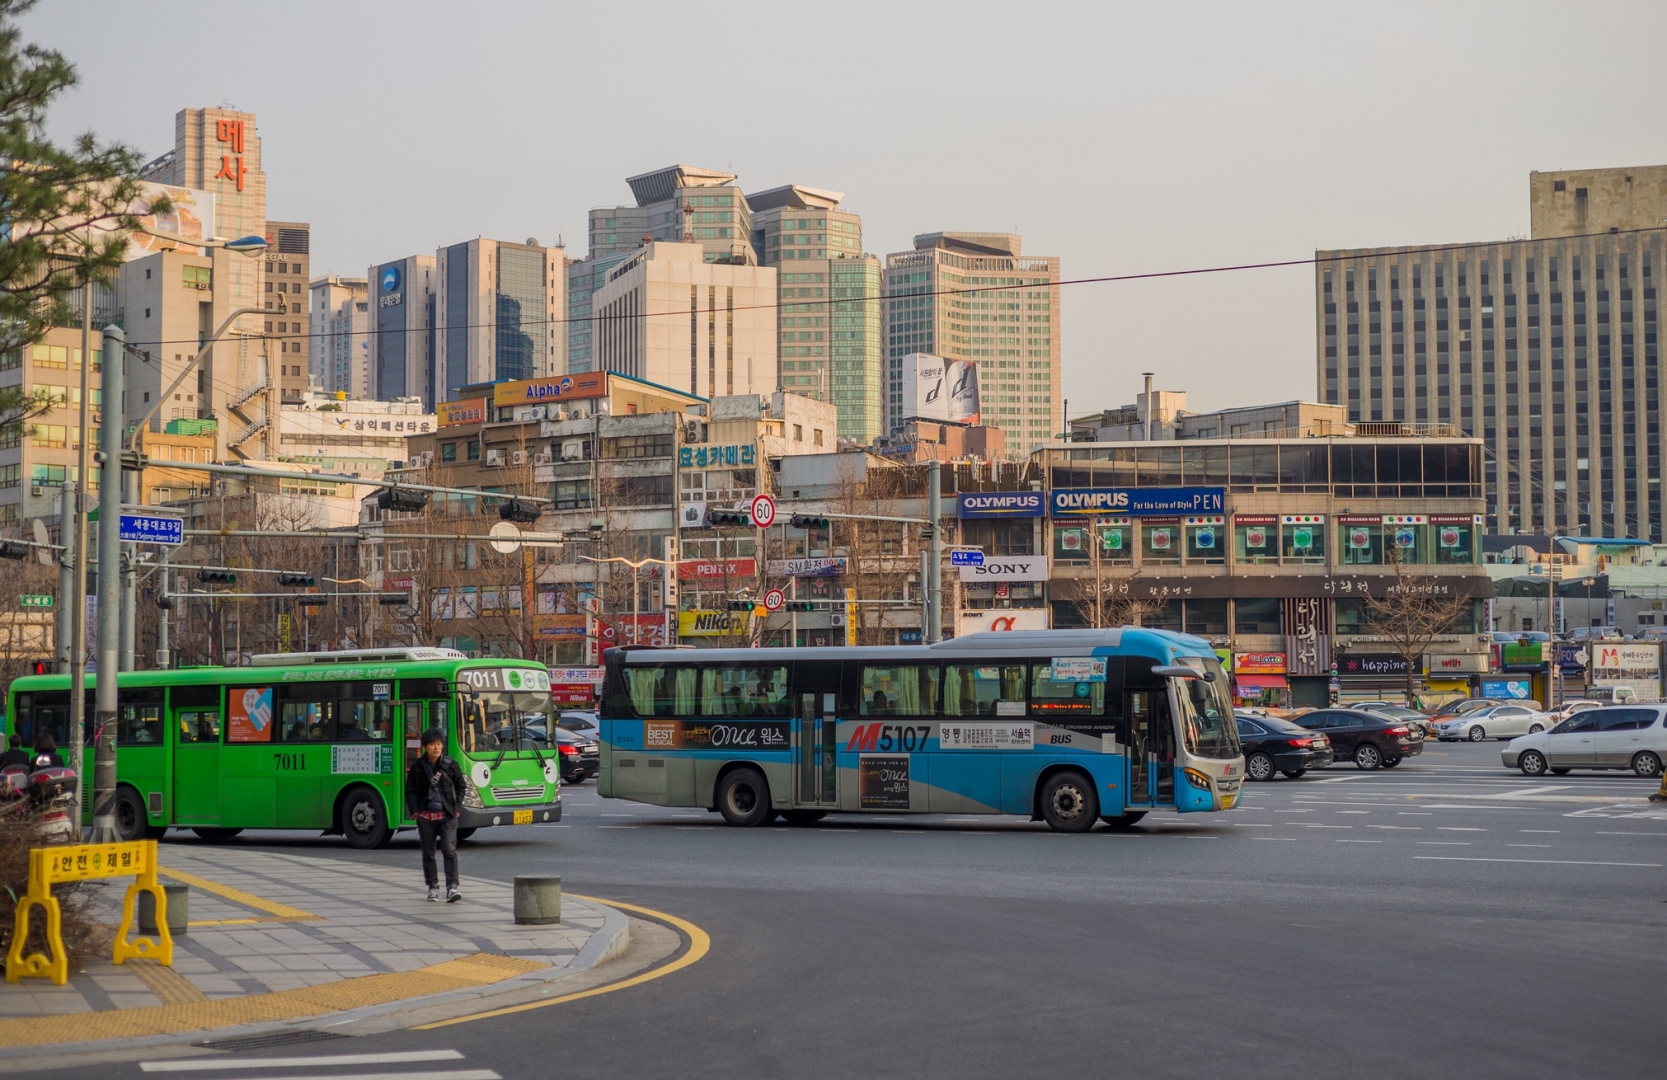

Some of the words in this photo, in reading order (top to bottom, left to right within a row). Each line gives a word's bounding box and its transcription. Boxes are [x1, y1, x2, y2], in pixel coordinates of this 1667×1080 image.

[216, 119, 247, 191] 메사
[526, 384, 561, 399] Alpha
[354, 419, 430, 432] 삼익패션타운
[680, 444, 756, 467] 효성카메라
[964, 496, 1039, 508] OLYMPUS
[1056, 492, 1129, 507] OLYMPUS
[1133, 502, 1142, 510] For
[1143, 502, 1154, 510] the
[1154, 501, 1168, 510] Love
[1169, 501, 1176, 509] of
[1177, 500, 1192, 510] Style
[1193, 494, 1221, 510] PEN
[756, 503, 770, 519] 60
[133, 519, 180, 532] 세종대로9길
[788, 559, 822, 573] SM환전
[975, 564, 1031, 574] SONY
[393, 580, 412, 588] PENTAX
[767, 594, 780, 605] 60
[694, 614, 741, 630] Nikon
[1362, 658, 1415, 673] happines
[1441, 658, 1461, 667] with
[463, 670, 499, 688] 7011
[374, 685, 388, 693] 7011
[647, 729, 675, 739] BEST
[760, 727, 784, 745] 원스
[1010, 728, 1031, 738] 서울역
[1050, 734, 1072, 744] BUS
[273, 753, 305, 771] 7011
[894, 782, 908, 793] 원스
[61, 855, 87, 871] 안전
[107, 852, 132, 867] 제일
